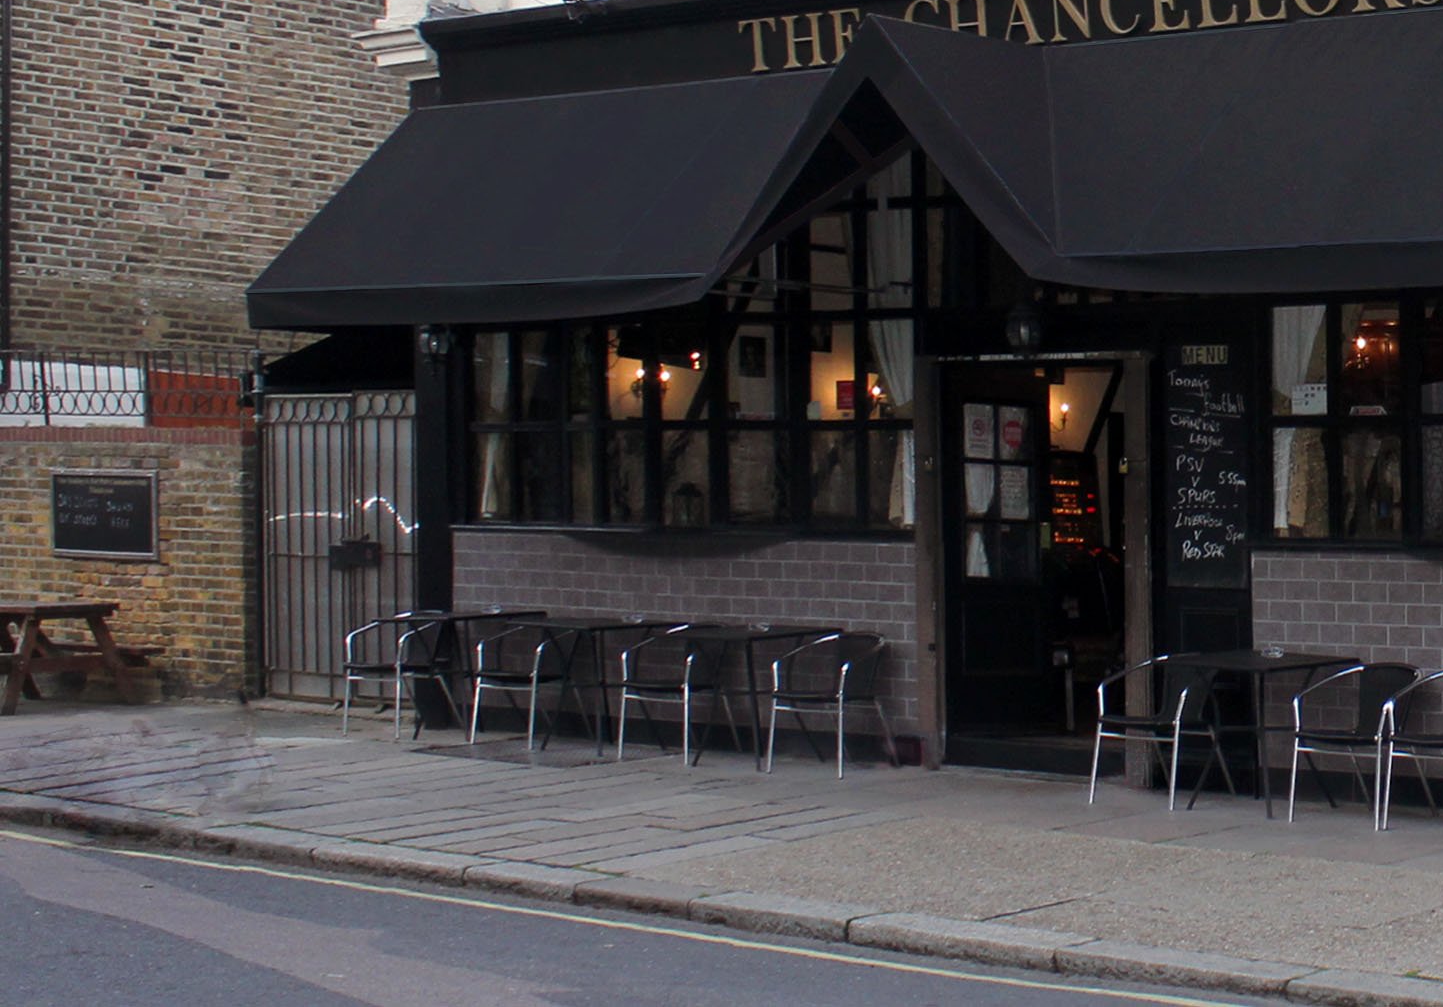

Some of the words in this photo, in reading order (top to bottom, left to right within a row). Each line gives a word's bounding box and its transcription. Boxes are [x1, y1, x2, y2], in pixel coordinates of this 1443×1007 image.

[738, 8, 860, 72] THE
[1182, 345, 1227, 364] MENU
[1176, 454, 1205, 473] PSV
